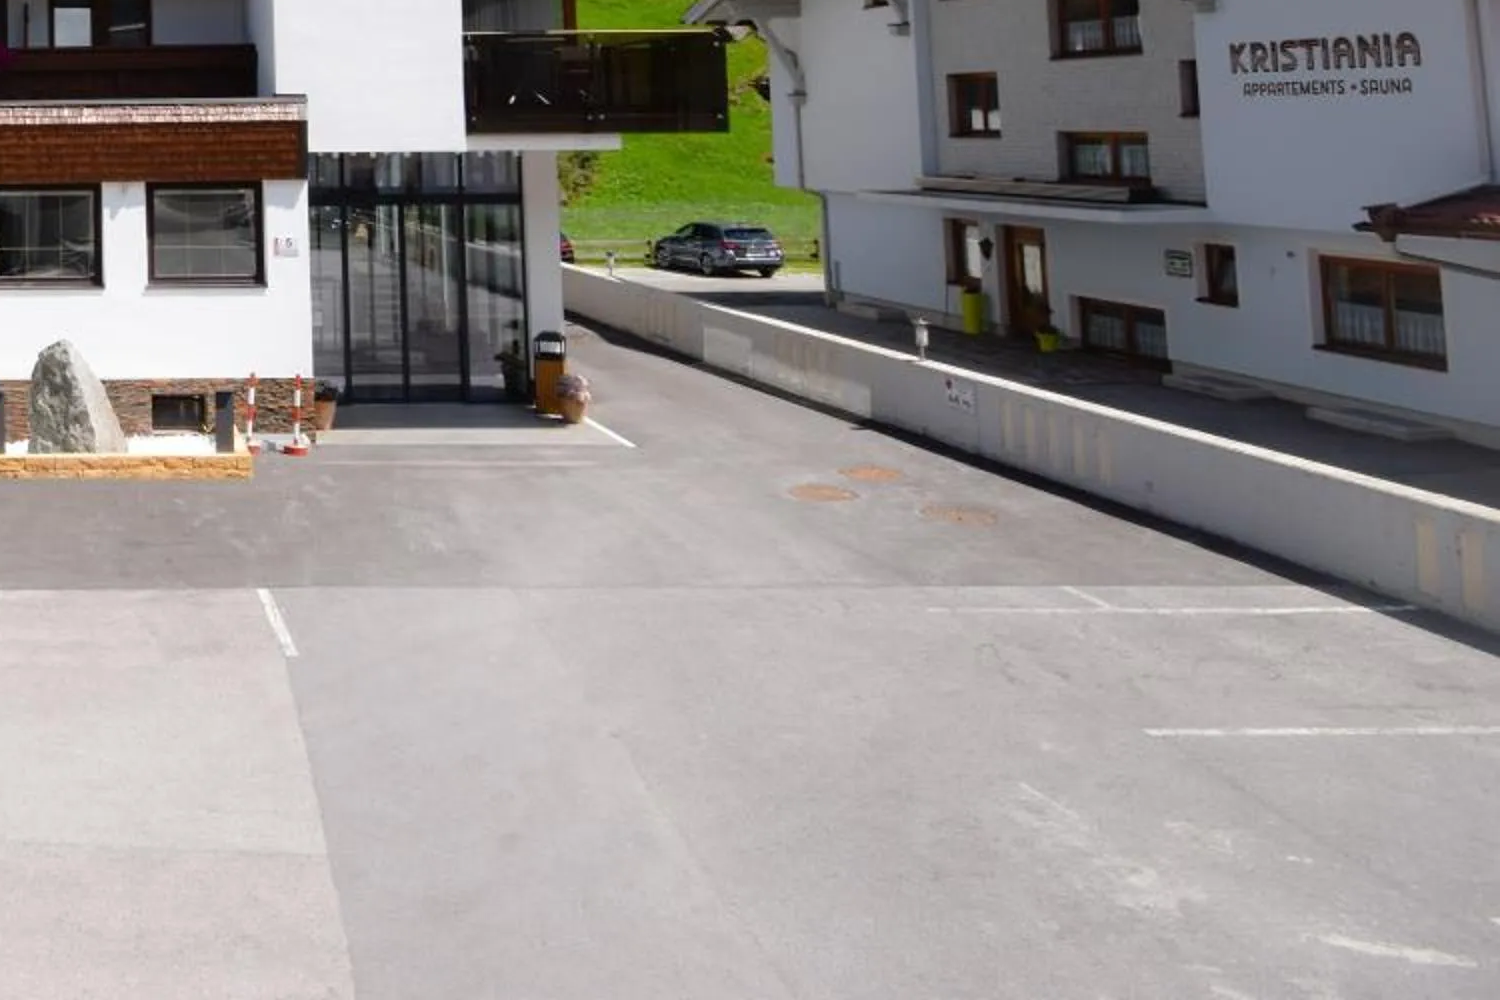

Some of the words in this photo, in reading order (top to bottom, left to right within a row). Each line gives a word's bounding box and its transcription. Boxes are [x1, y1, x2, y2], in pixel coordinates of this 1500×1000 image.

[1229, 31, 1422, 74] KRISTIANIA
[1243, 79, 1345, 96] APPARTEMENTS
[1359, 77, 1413, 95] SAUNA
